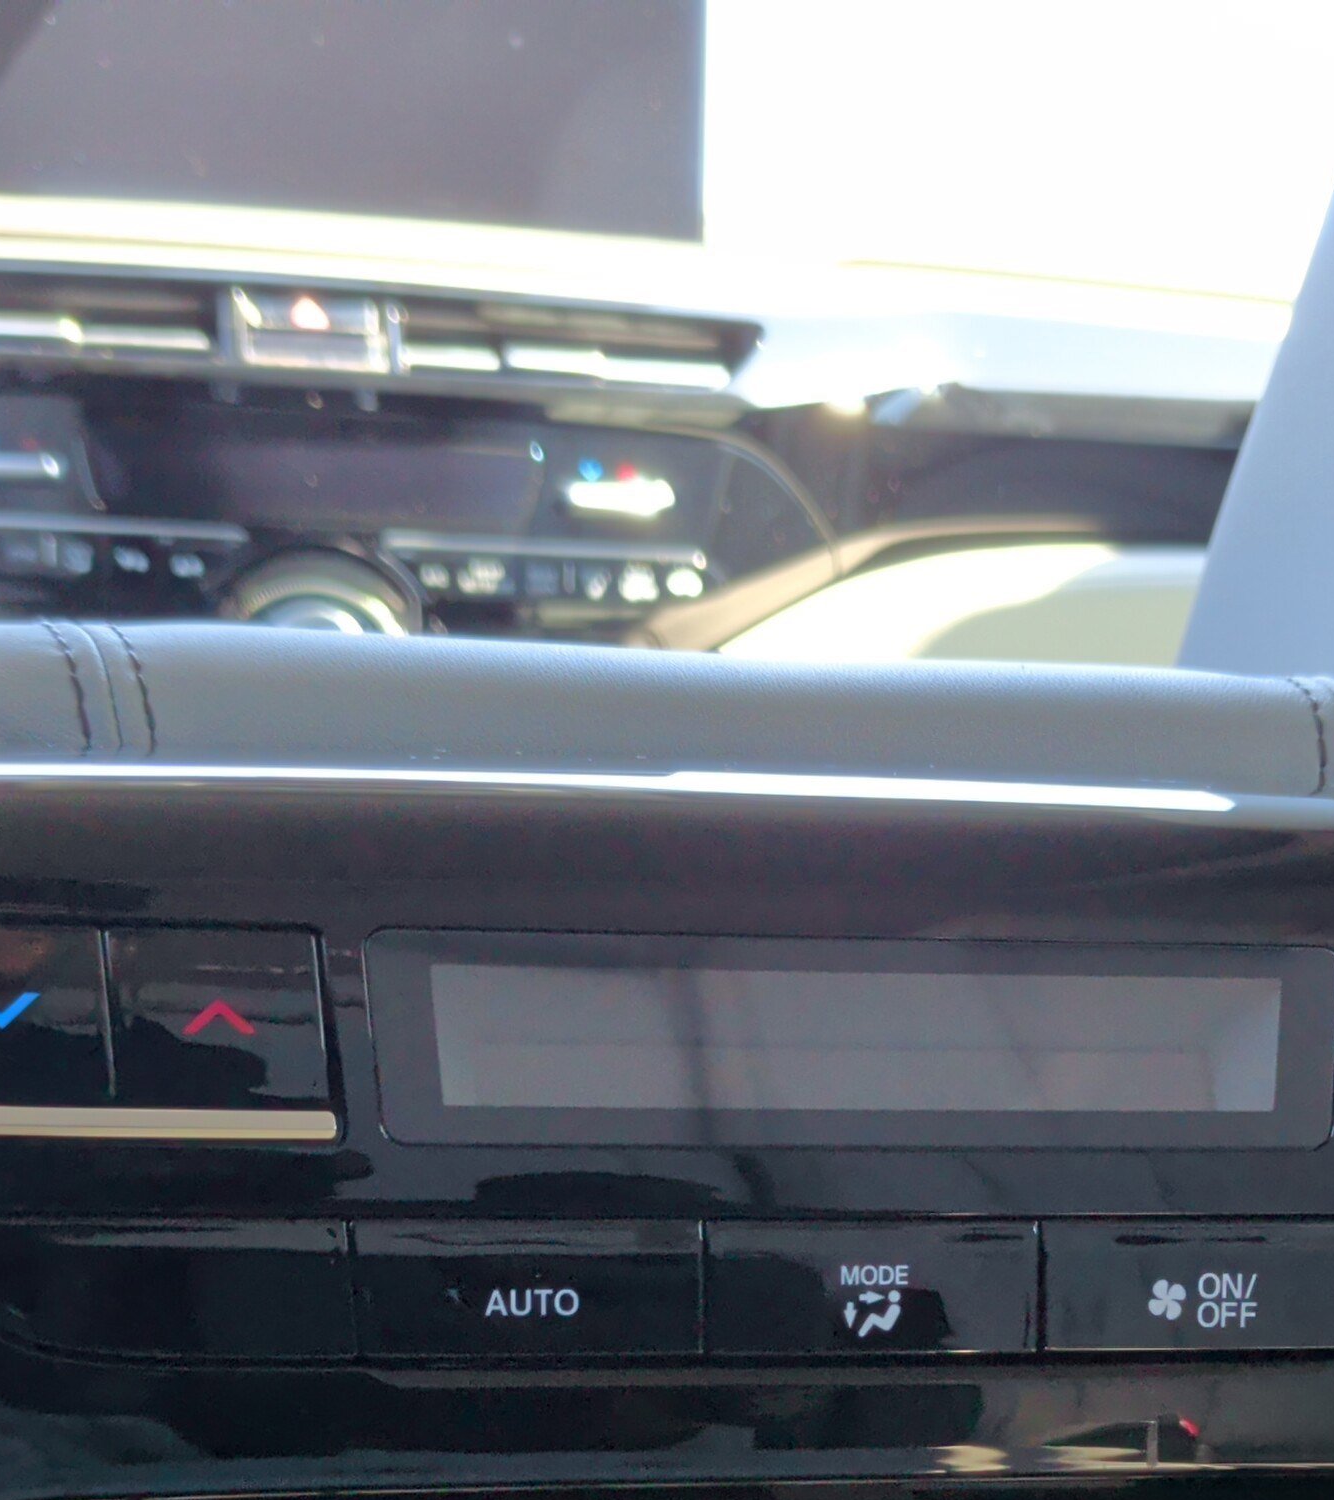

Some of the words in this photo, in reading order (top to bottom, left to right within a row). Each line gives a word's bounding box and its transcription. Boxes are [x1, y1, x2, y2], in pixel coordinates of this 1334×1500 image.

[840, 1264, 909, 1286] MODE
[1197, 1272, 1258, 1299] ON/
[485, 1288, 579, 1316] AUTO
[1197, 1301, 1258, 1328] OFF
